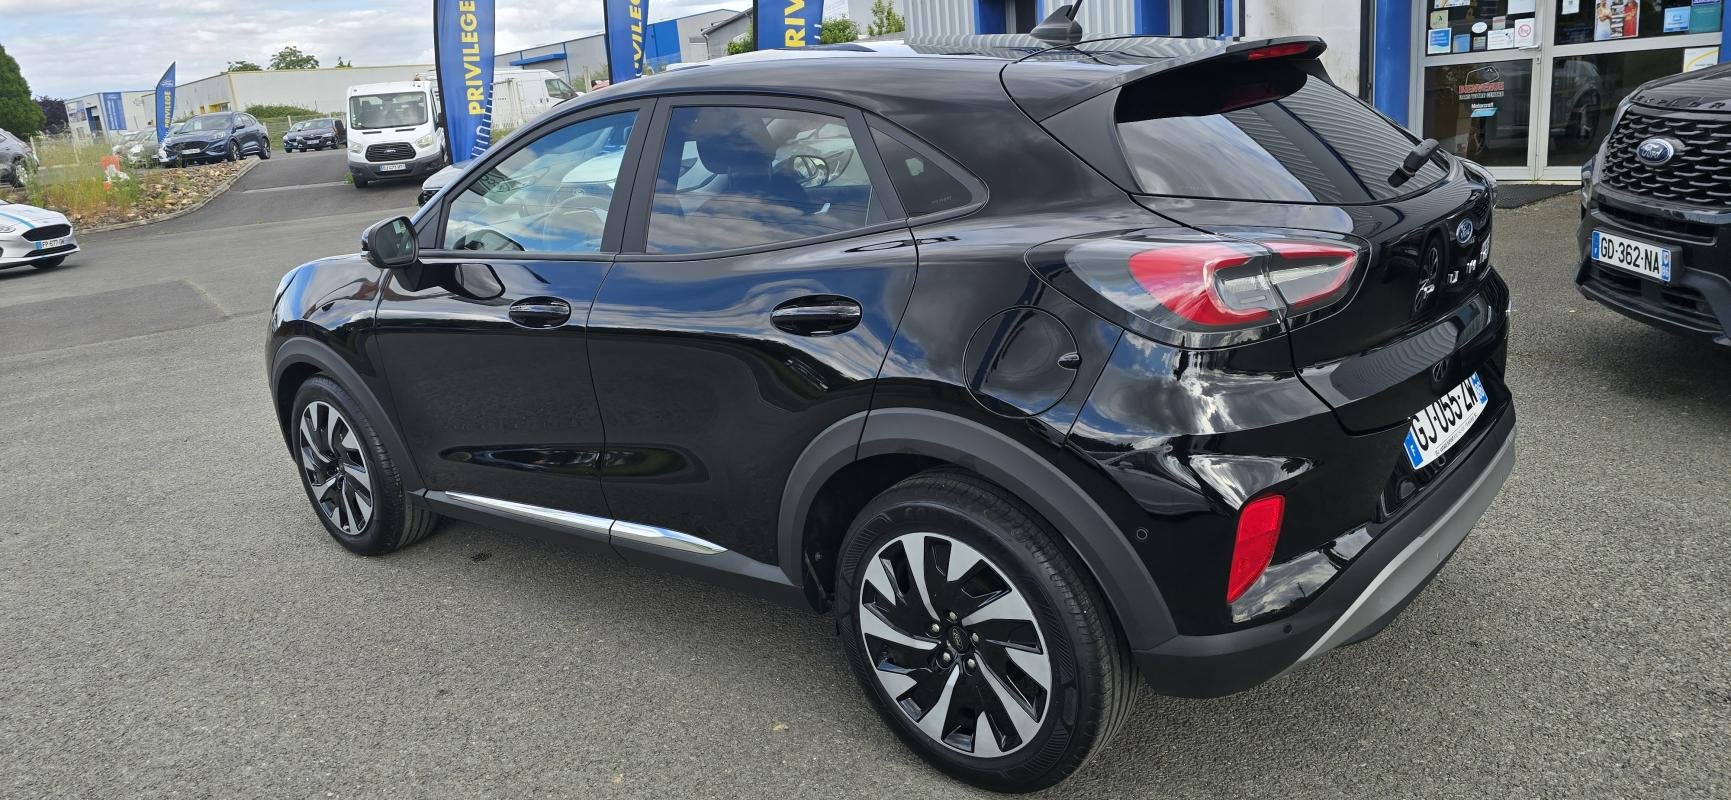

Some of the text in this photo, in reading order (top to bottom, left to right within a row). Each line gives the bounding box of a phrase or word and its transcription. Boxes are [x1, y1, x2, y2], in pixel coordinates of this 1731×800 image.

[459, 0, 486, 115] PRIVILEGE
[1639, 142, 1668, 160] Ford
[1600, 236, 1660, 275] GD-362-NA
